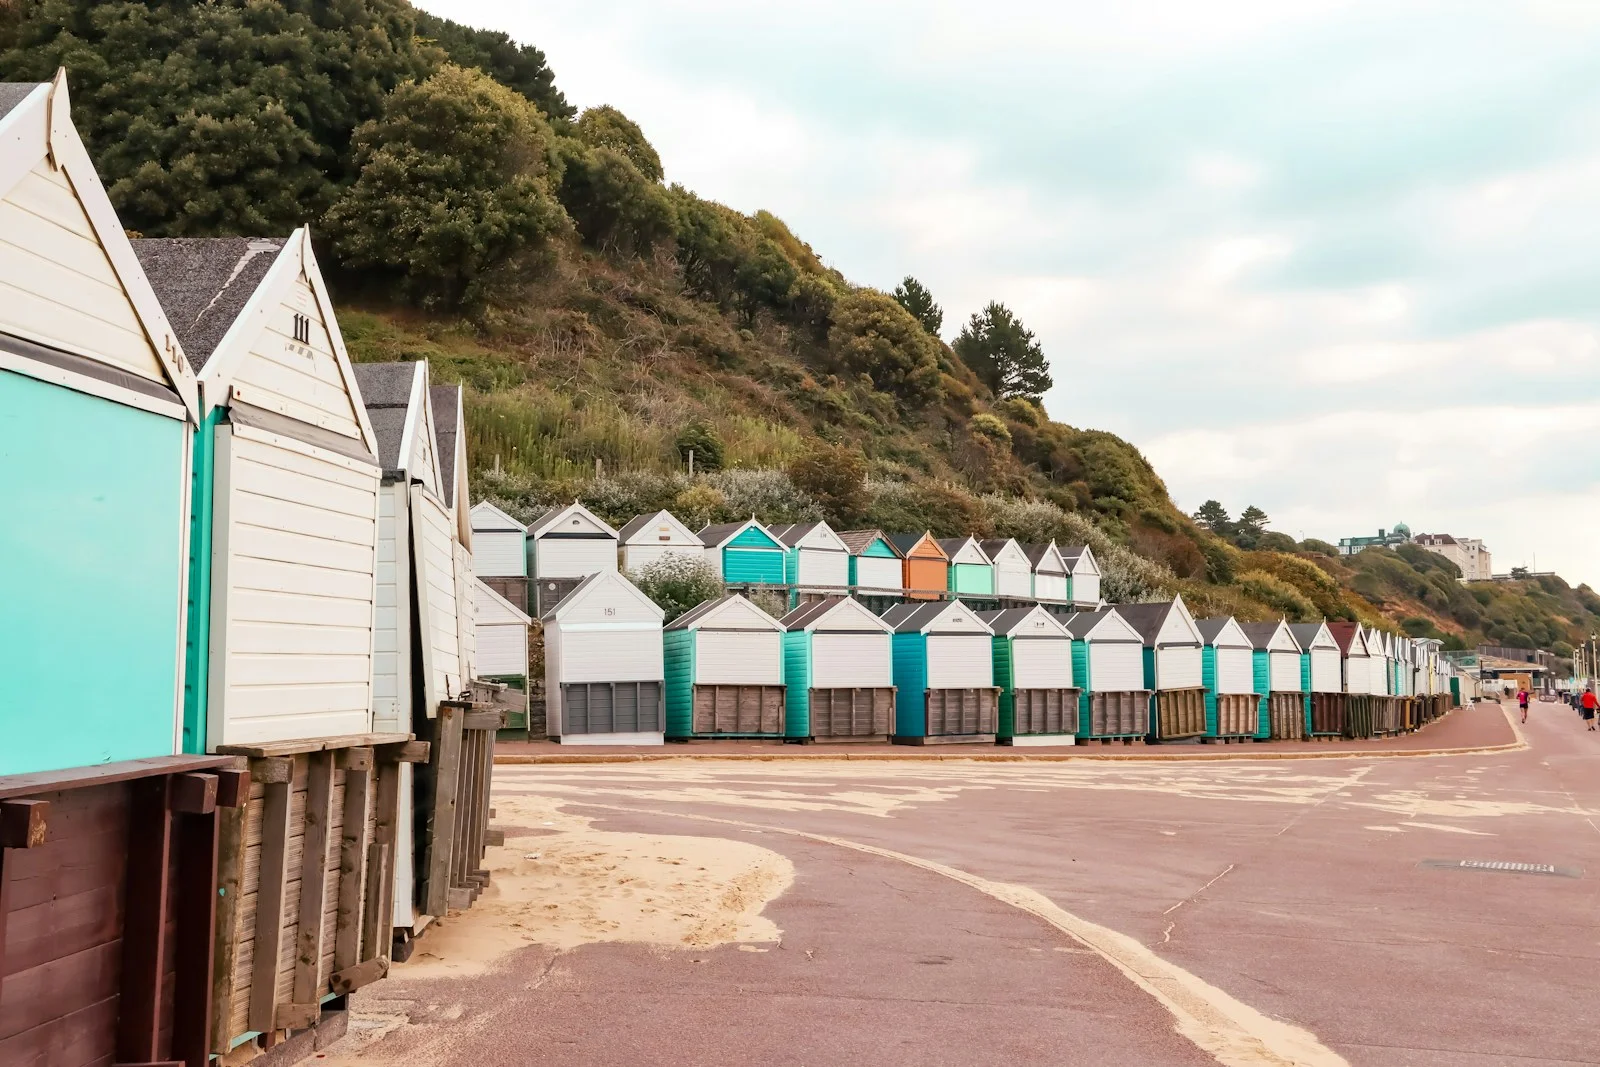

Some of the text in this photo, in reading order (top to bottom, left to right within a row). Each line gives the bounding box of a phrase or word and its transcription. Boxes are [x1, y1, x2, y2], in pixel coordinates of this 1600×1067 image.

[293, 313, 310, 345] 111
[165, 334, 184, 374] 110
[604, 607, 616, 616] 151
